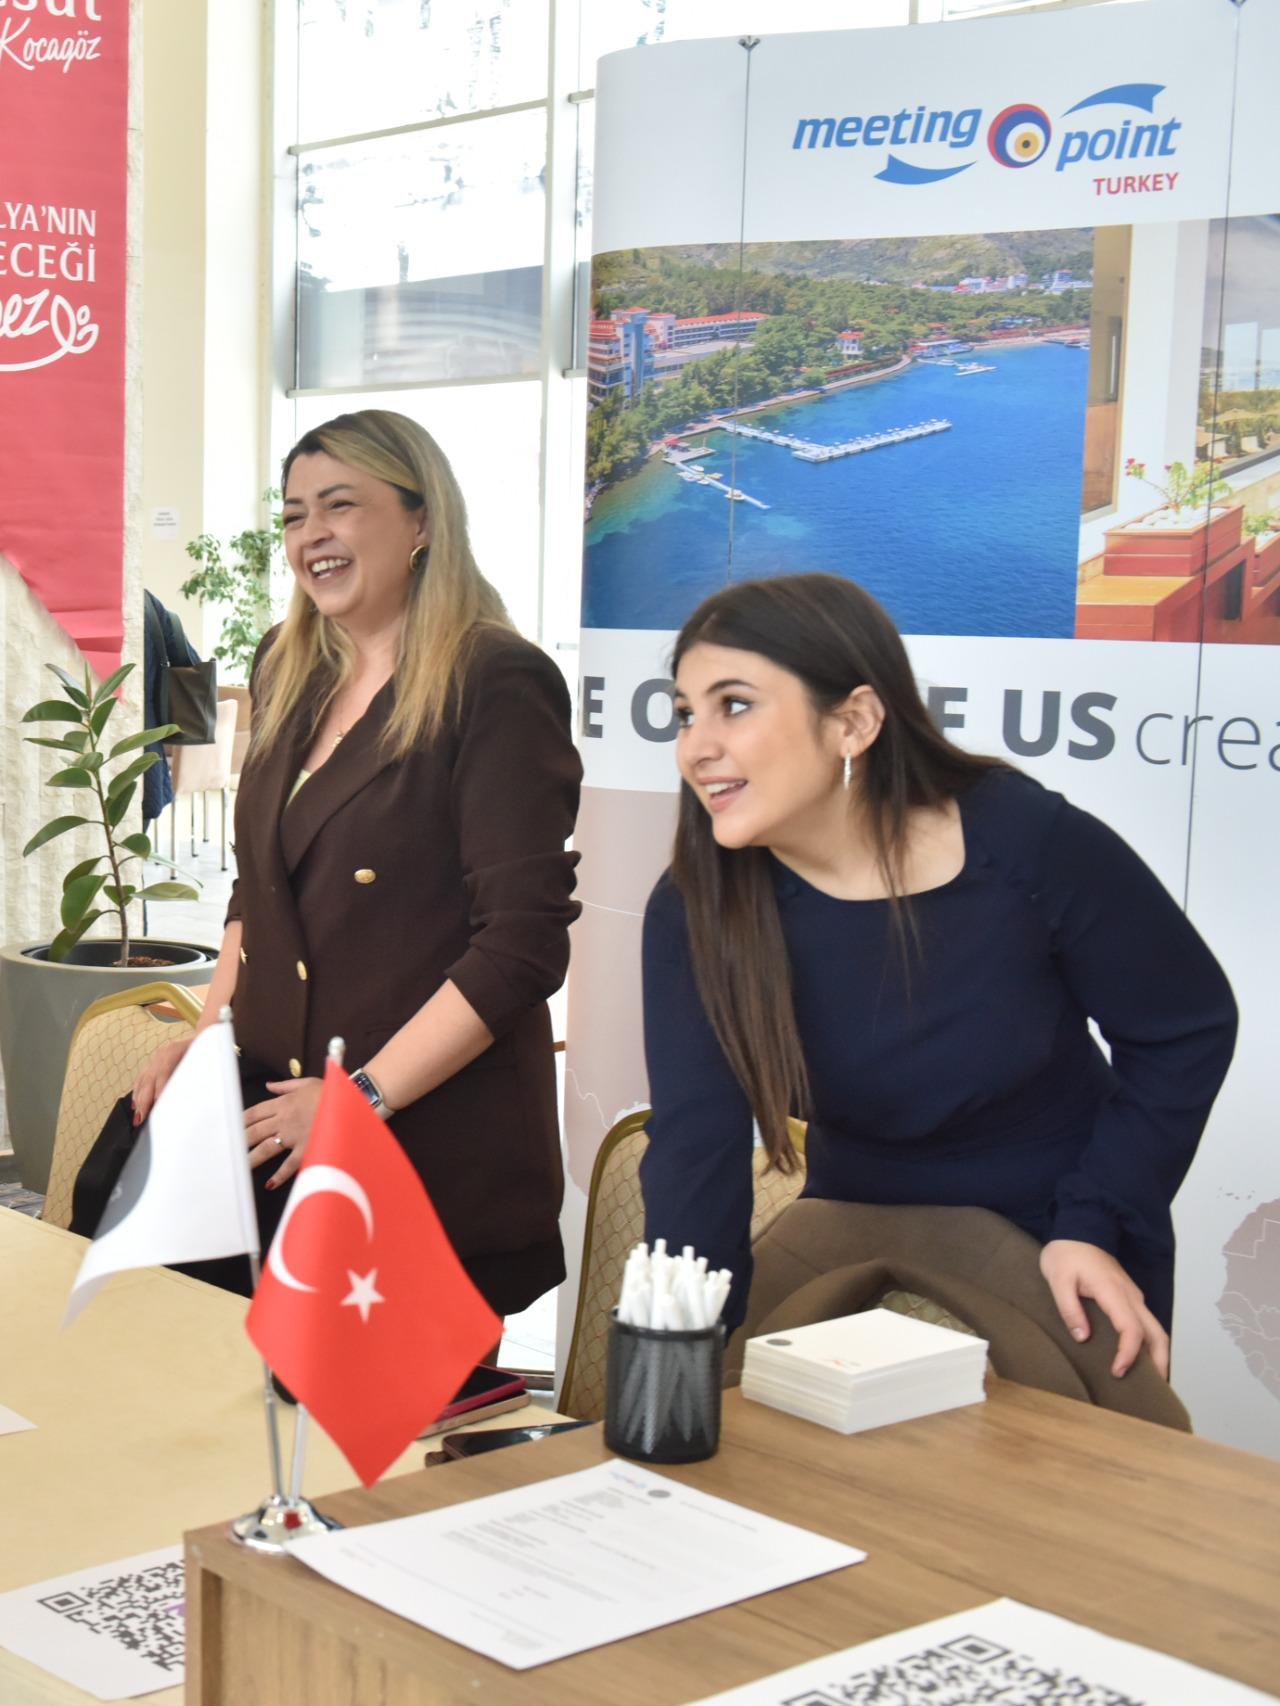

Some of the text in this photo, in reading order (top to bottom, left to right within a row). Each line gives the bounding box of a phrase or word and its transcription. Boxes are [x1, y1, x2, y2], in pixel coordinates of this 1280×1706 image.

[792, 105, 1182, 172] meeting point
[1093, 172, 1178, 196] TURKEY
[1002, 689, 1118, 761] US
